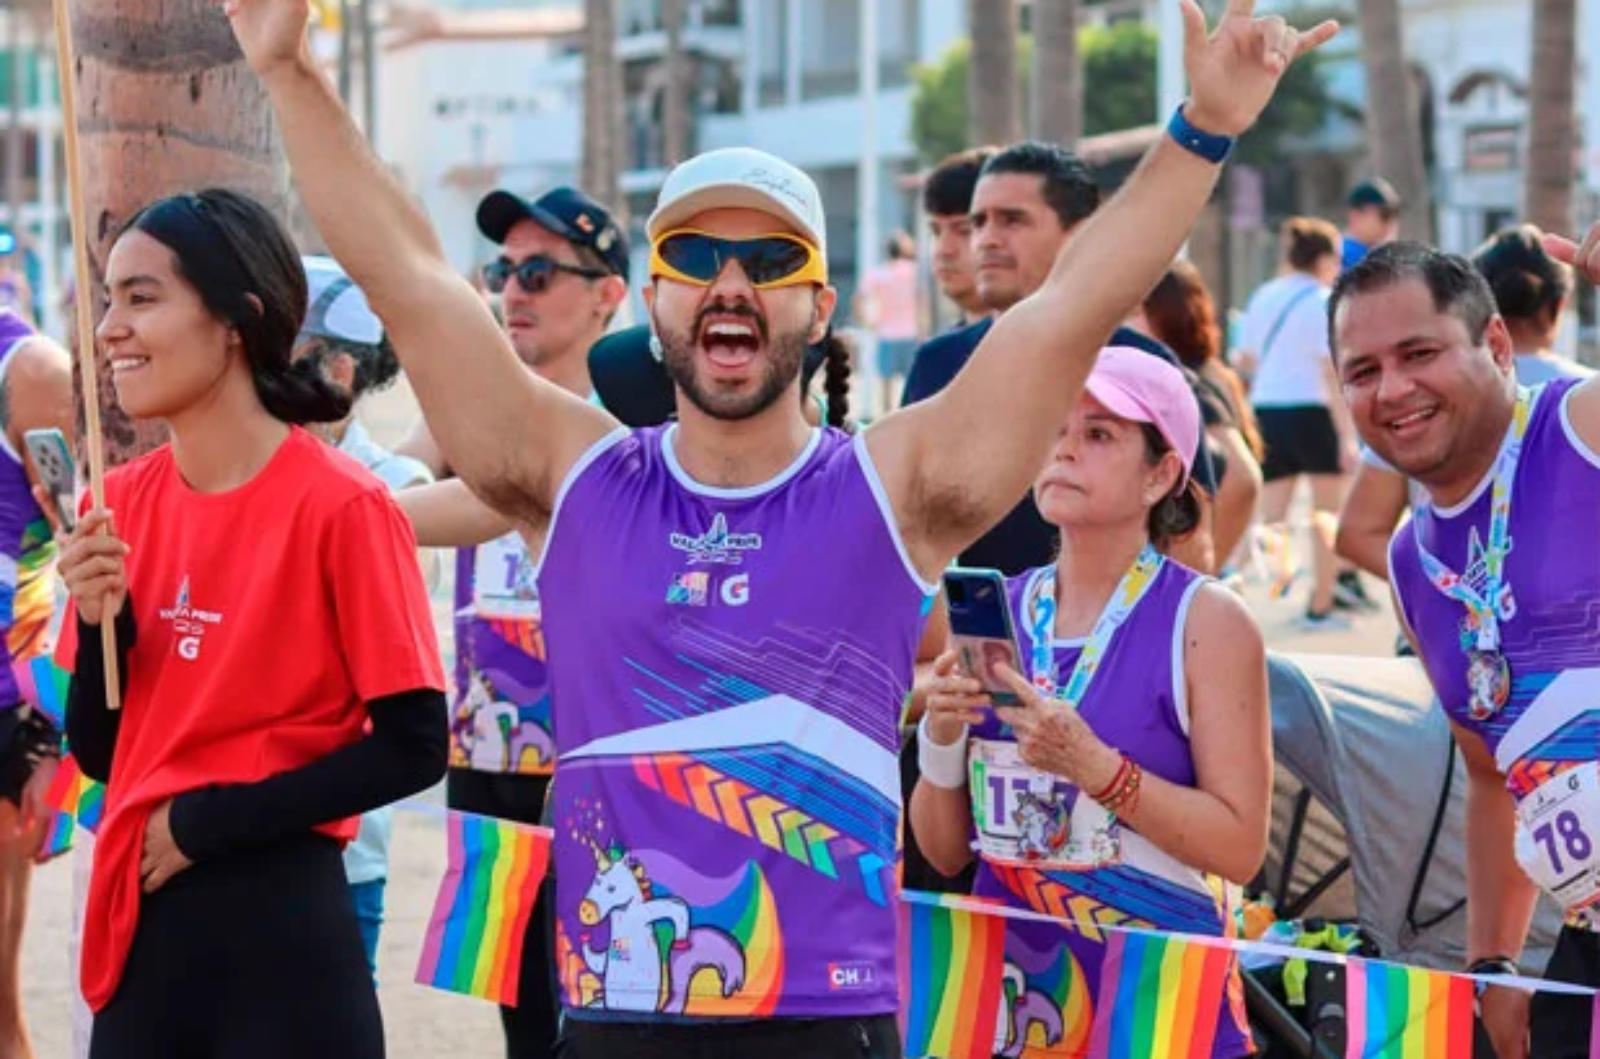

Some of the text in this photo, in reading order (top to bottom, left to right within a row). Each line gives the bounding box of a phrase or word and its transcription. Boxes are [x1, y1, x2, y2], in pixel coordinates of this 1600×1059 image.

[721, 572, 749, 606] G
[178, 636, 200, 660] G
[1533, 810, 1592, 875] 78
